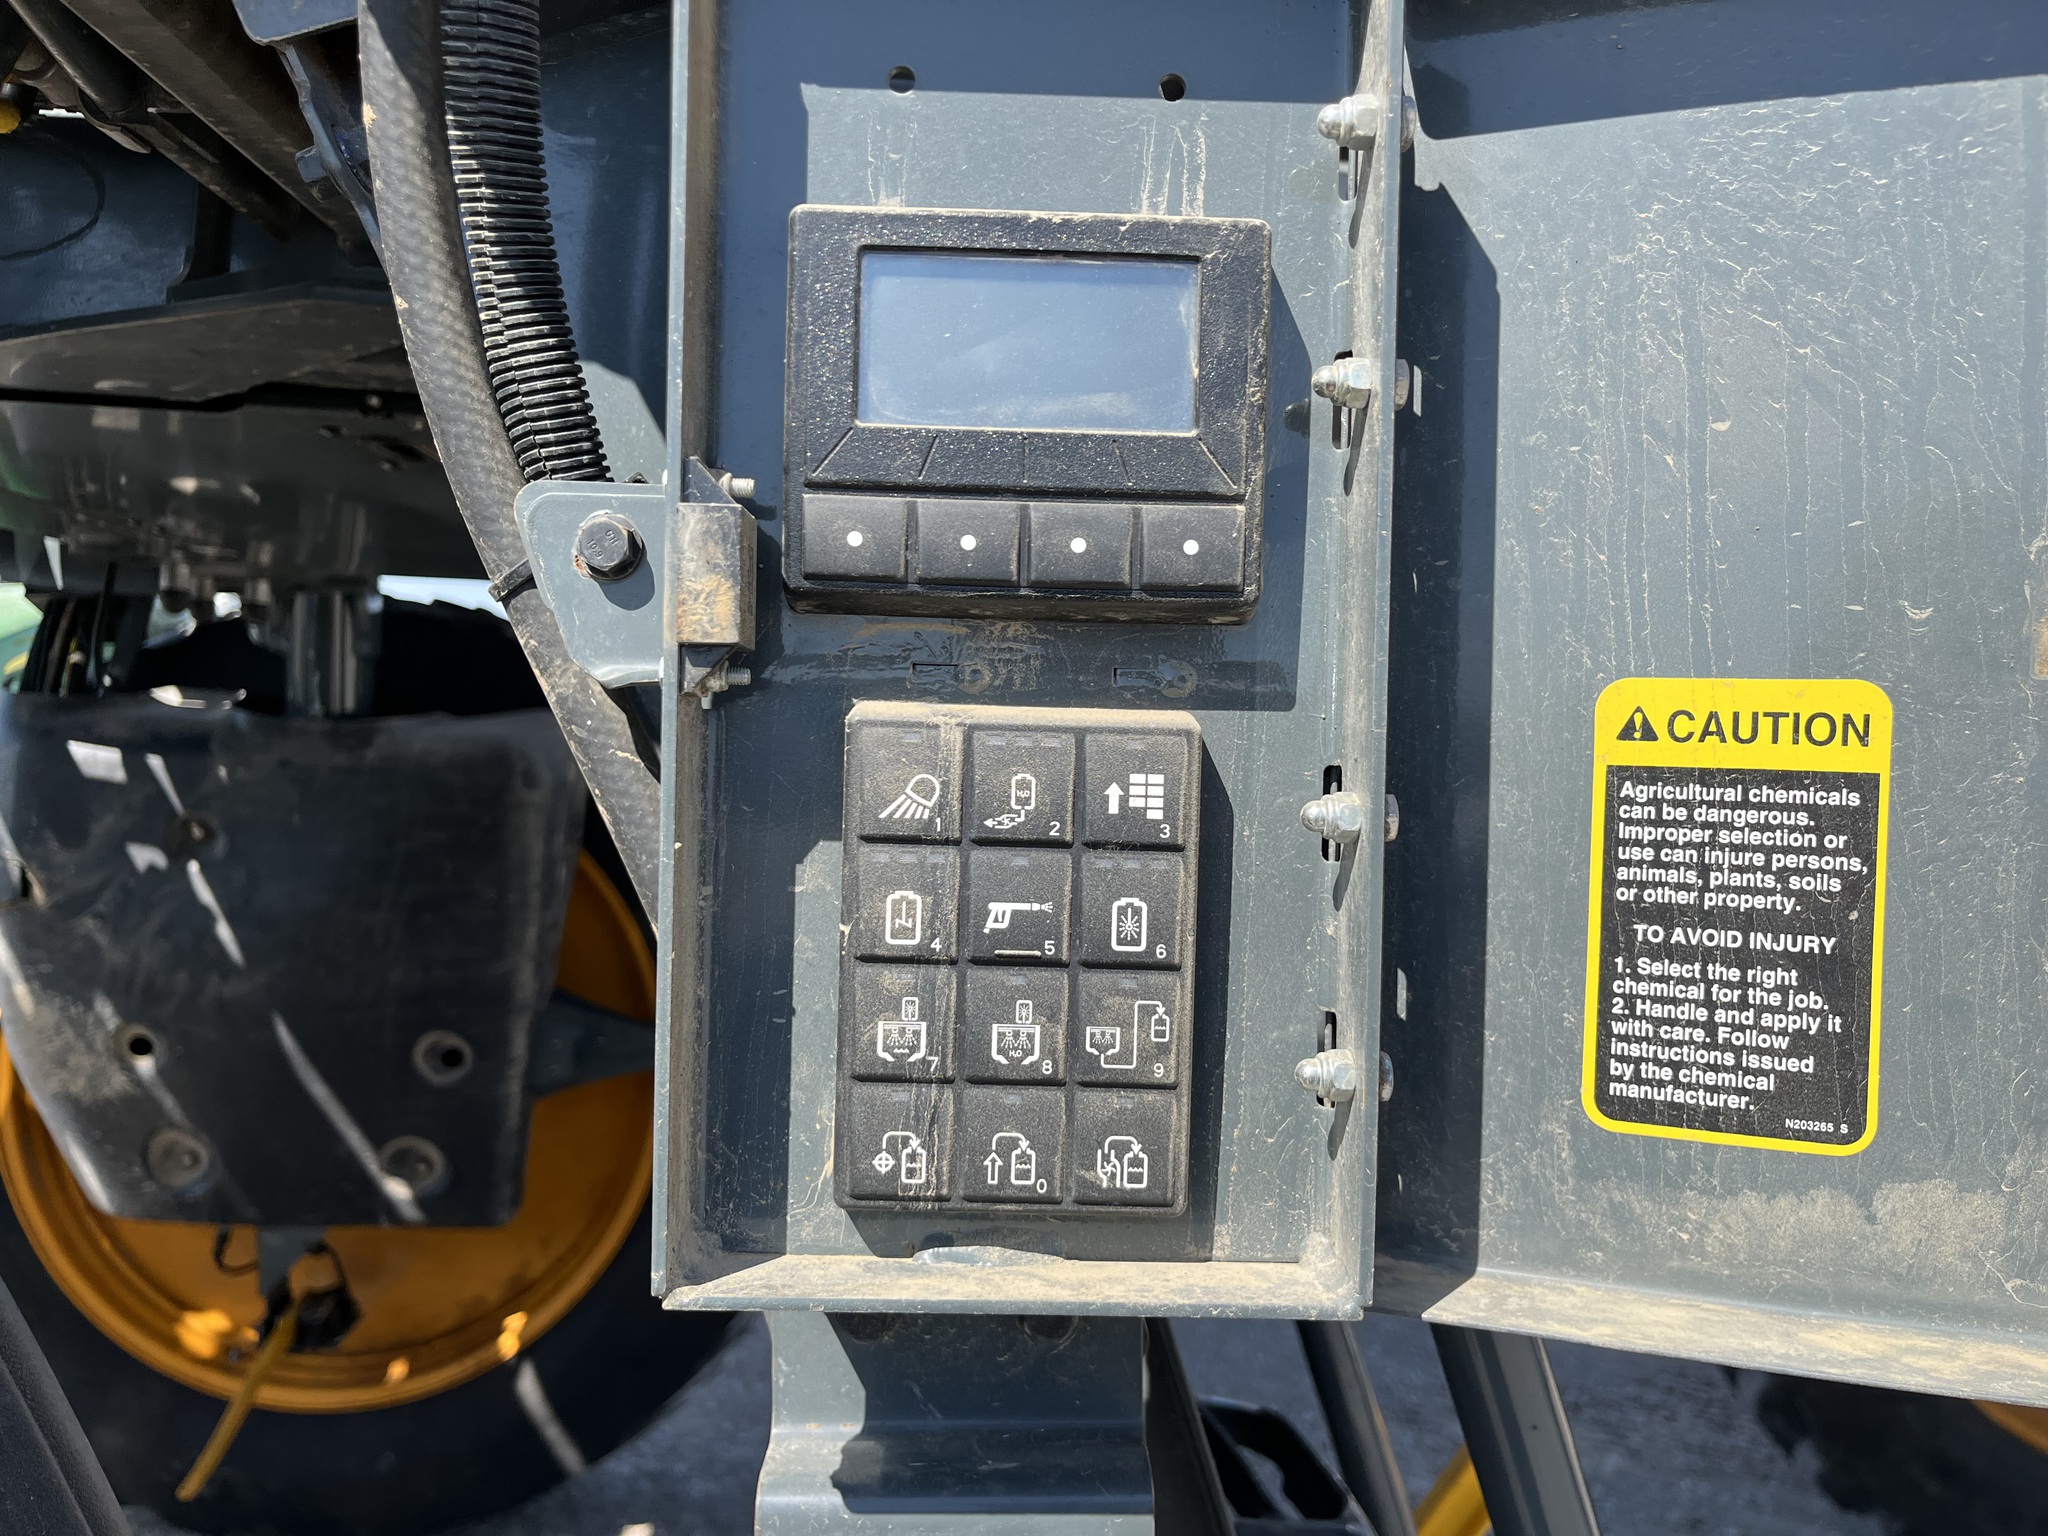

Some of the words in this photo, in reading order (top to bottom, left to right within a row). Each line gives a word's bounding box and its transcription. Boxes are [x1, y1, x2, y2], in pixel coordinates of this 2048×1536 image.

[1667, 709, 1871, 747] CAUTION
[1619, 781, 1742, 802] Agricultural
[1748, 785, 1860, 806] chemicals
[935, 819, 940, 832] 1
[1619, 806, 1656, 819] can
[1662, 803, 1687, 820] be
[1694, 805, 1814, 826] dangerous.
[1049, 821, 1060, 835] 2
[1159, 824, 1170, 838] 3
[1618, 823, 1713, 845] Improper
[1718, 827, 1816, 847] selection
[1823, 833, 1848, 848] or
[1618, 846, 1654, 861] use
[1660, 848, 1697, 862] can
[1704, 847, 1765, 868] injure
[1771, 853, 1867, 874] persons,
[1616, 865, 1702, 886] animals,
[1709, 869, 1781, 890] plants,
[1788, 873, 1842, 891] soils
[1616, 888, 1637, 901] or
[1643, 887, 1698, 904] other
[1703, 892, 1801, 914] property.
[931, 938, 942, 951] 4
[1044, 941, 1055, 954] 5
[1156, 944, 1167, 957] 6
[1633, 925, 1665, 943] TO
[1670, 928, 1742, 948] AVOID
[1749, 932, 1836, 954] INJURY
[1614, 956, 1631, 973] 1.
[1637, 957, 1701, 978] Select
[1707, 964, 1741, 982] the
[1747, 967, 1798, 989] right
[1612, 977, 1705, 999] chemical
[1711, 984, 1741, 1002] for
[1747, 987, 1781, 1006] the
[1788, 990, 1828, 1011] job.
[1611, 997, 1629, 1015] 2.
[1636, 999, 1708, 1021] Handle
[1714, 1005, 1754, 1024] and
[1760, 1012, 1821, 1034] apply
[1827, 1014, 1841, 1032] it
[1611, 1018, 1653, 1036] with
[1659, 1024, 1710, 1043] care.
[1718, 1027, 1789, 1049] Follow
[926, 1056, 938, 1071] 7
[1042, 1060, 1052, 1074] 8
[1610, 1038, 1735, 1066] instructions
[1742, 1051, 1814, 1073] issued
[1154, 1064, 1164, 1078] 9
[1609, 1059, 1634, 1080] by
[1640, 1063, 1672, 1081] the
[1679, 1065, 1775, 1091] chemical
[1609, 1080, 1754, 1110] manufacturer.
[1785, 1118, 1834, 1133] N203265
[1840, 1123, 1849, 1134] S
